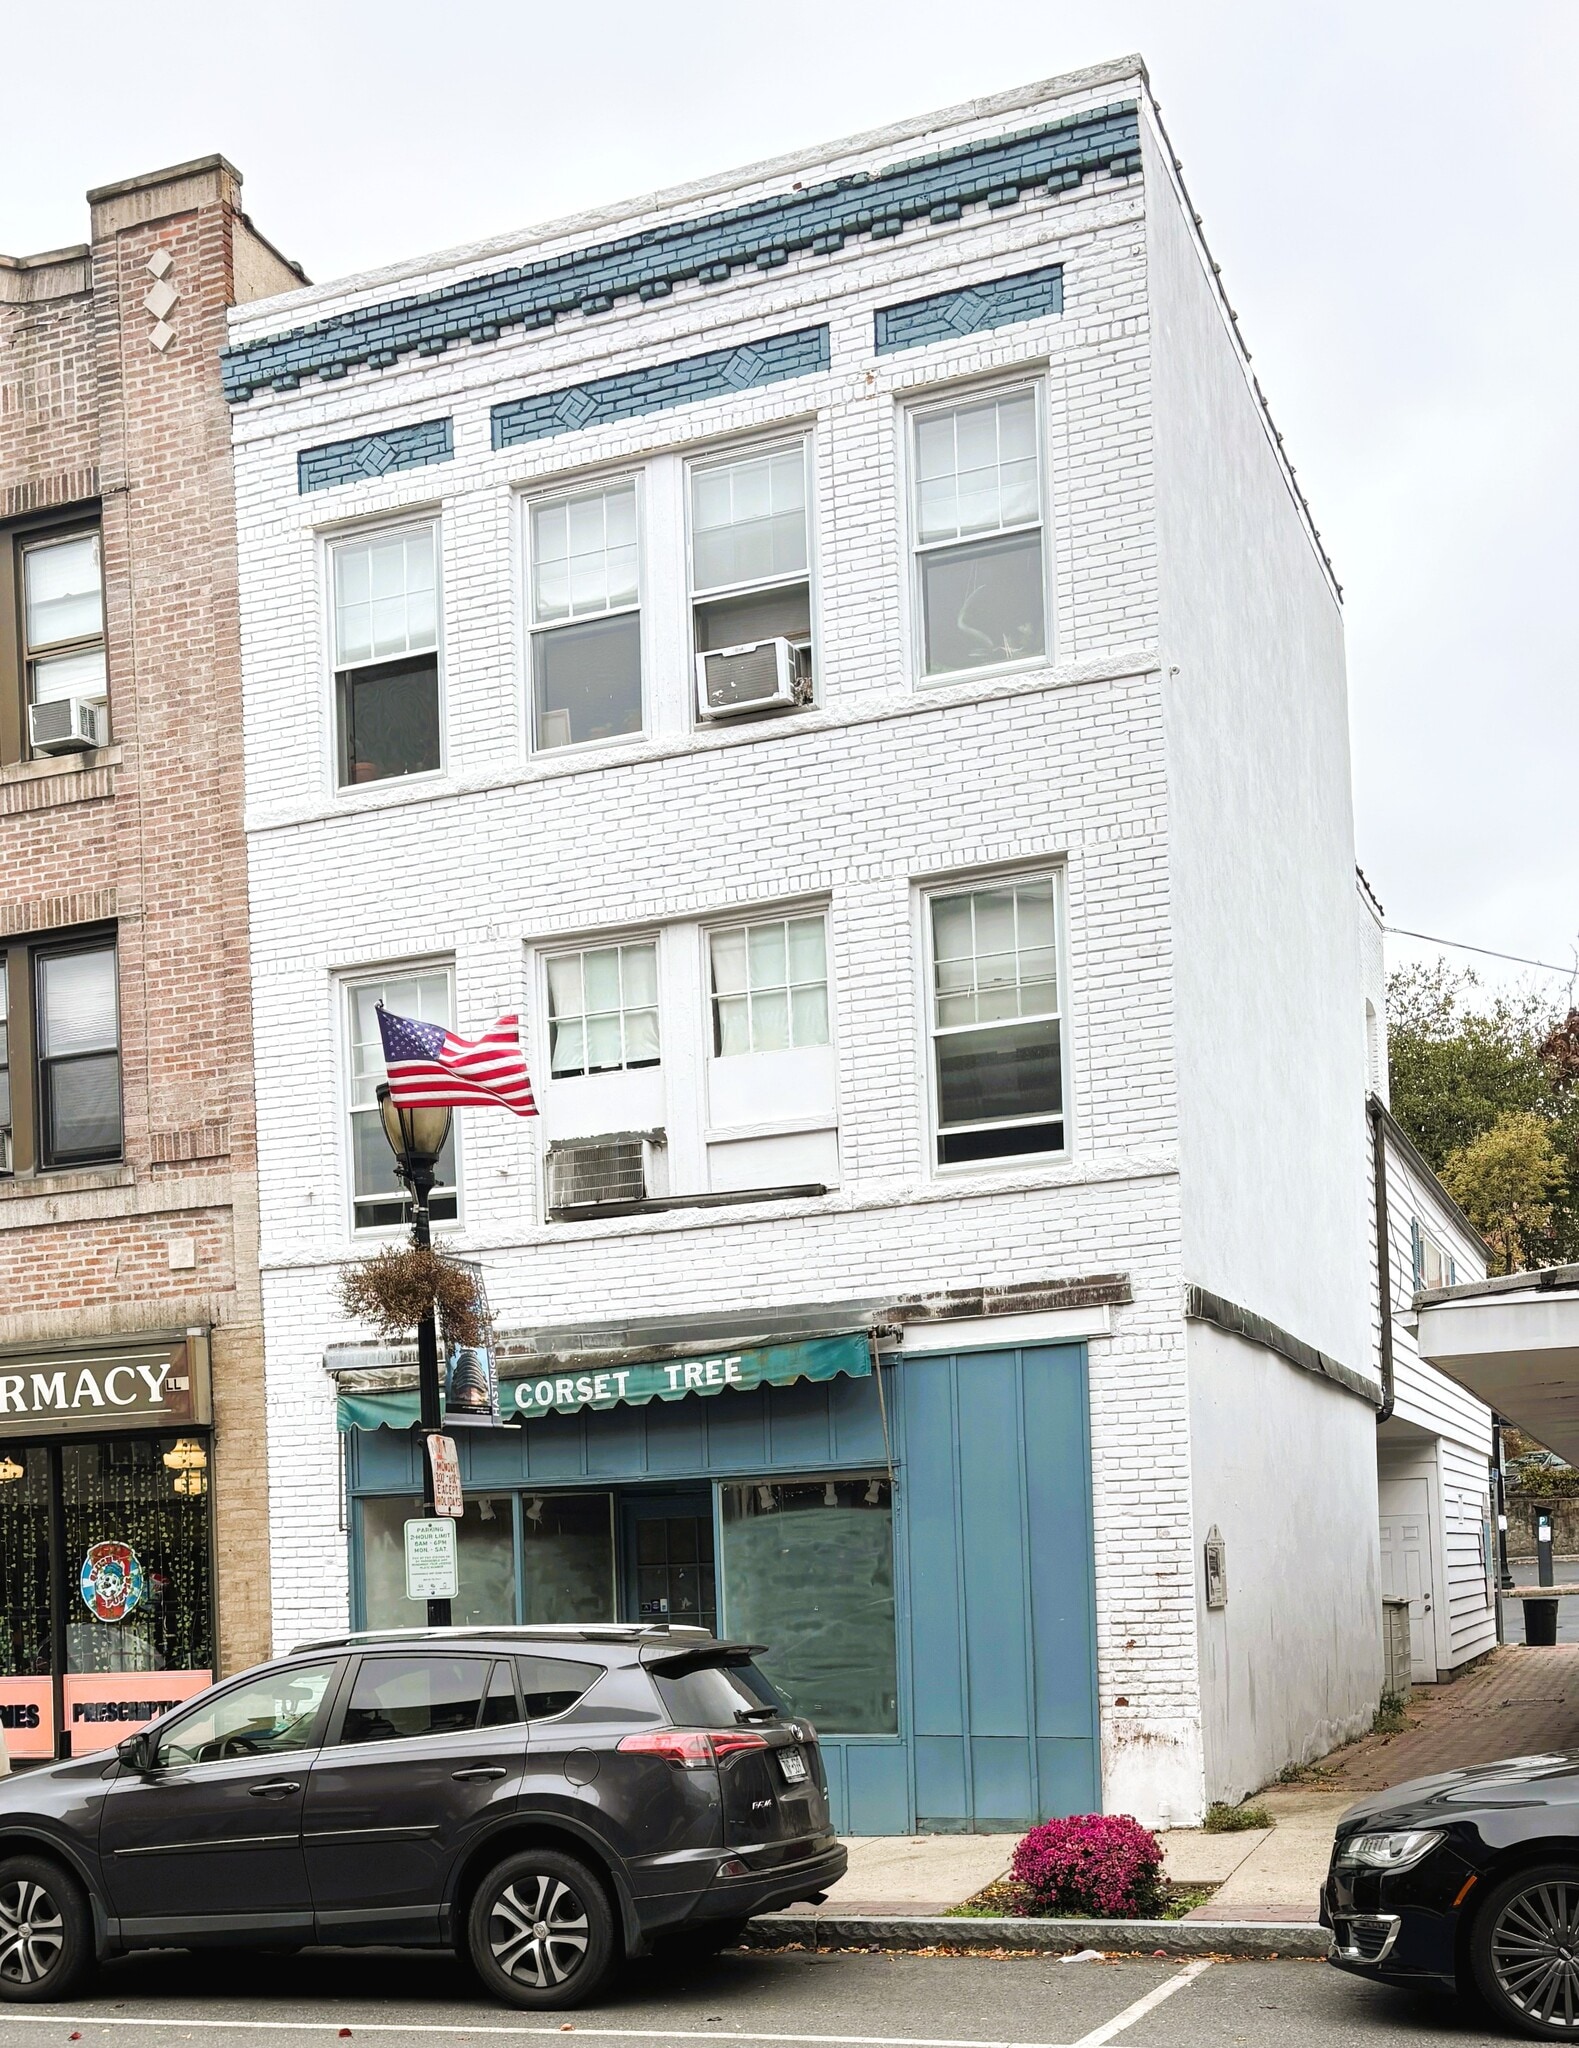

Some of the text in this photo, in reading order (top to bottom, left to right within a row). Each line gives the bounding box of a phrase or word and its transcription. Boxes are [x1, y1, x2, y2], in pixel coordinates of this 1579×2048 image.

[0, 1364, 171, 1414] RMACY
[488, 1351, 500, 1417] HASTINGS
[514, 1357, 743, 1408] CORSET TREE
[436, 1495, 462, 1507] HOLIDAYS
[437, 1484, 458, 1495] EXCEPT
